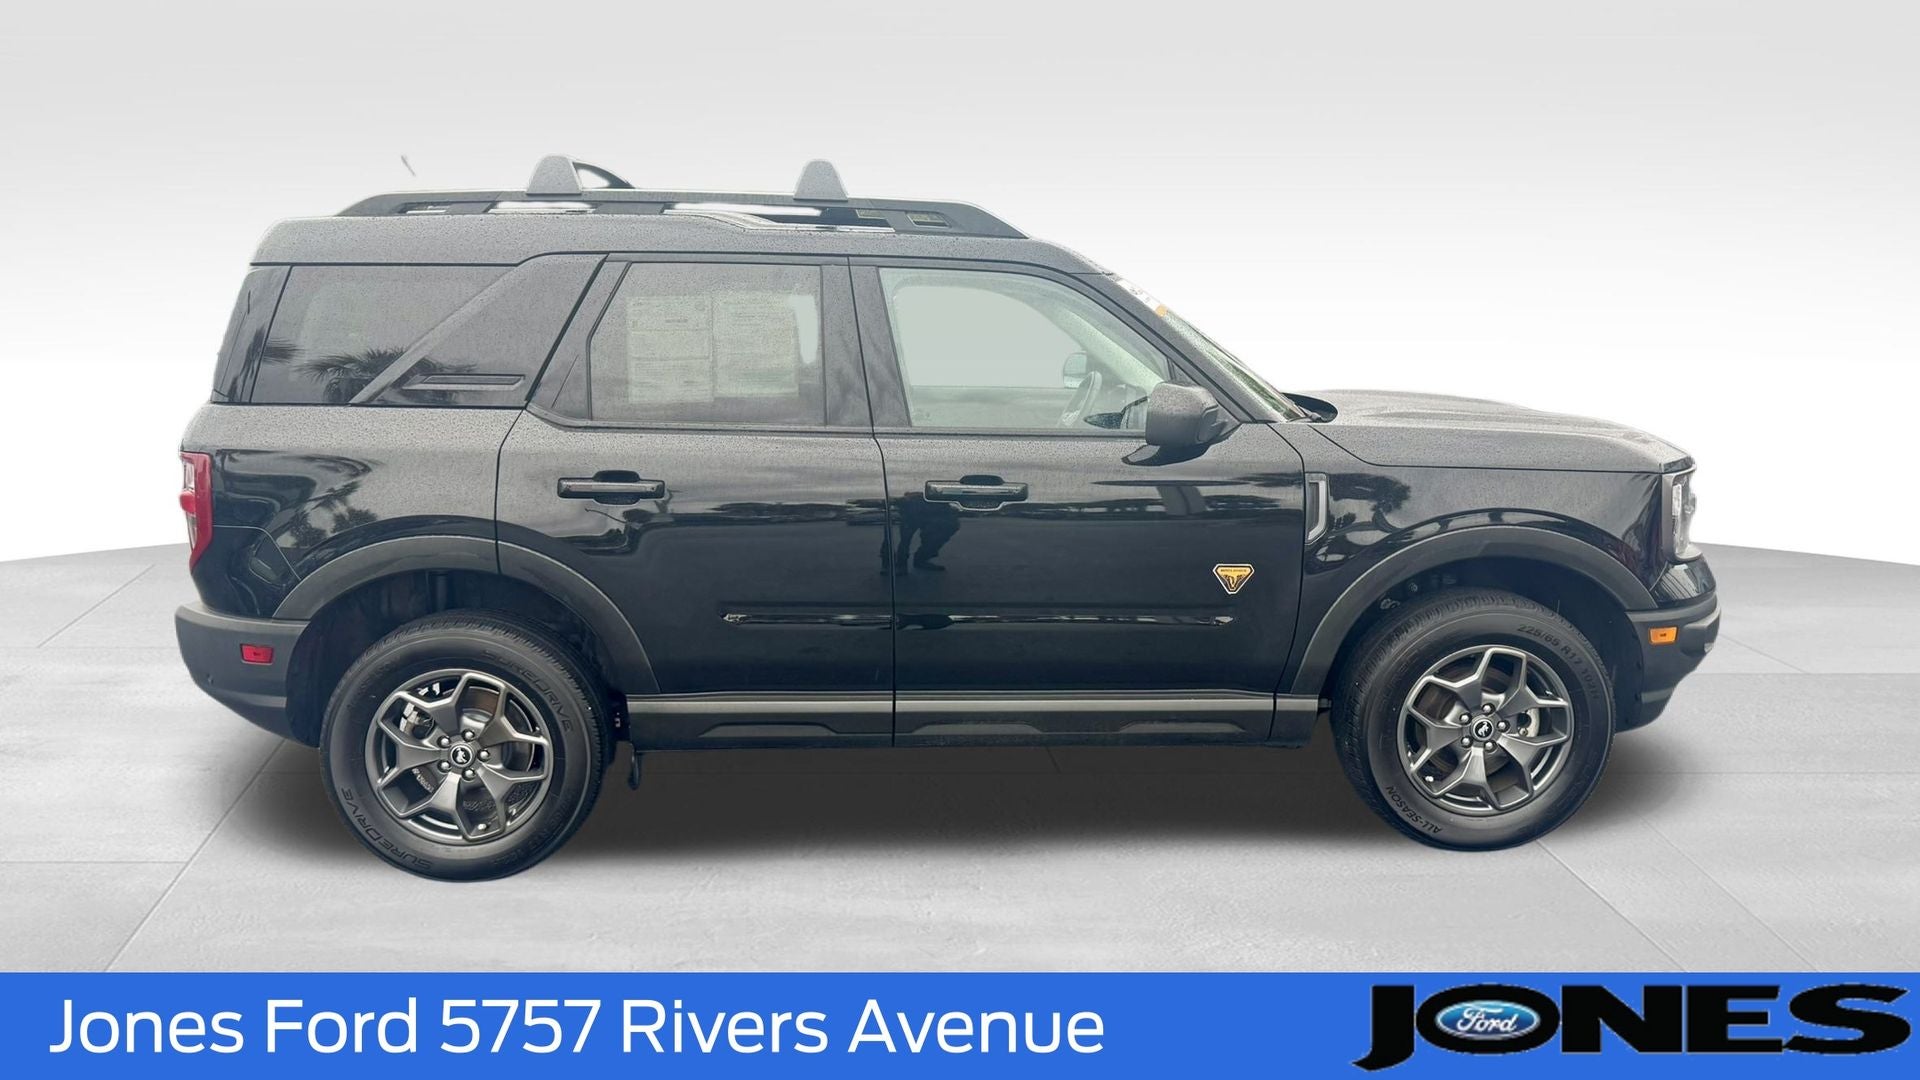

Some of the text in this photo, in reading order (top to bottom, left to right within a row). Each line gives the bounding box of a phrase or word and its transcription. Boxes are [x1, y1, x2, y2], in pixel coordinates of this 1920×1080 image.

[1517, 623, 1562, 647] 225/65
[341, 787, 434, 870] SUREDRIVE
[1385, 785, 1443, 835] ALL-SEASON
